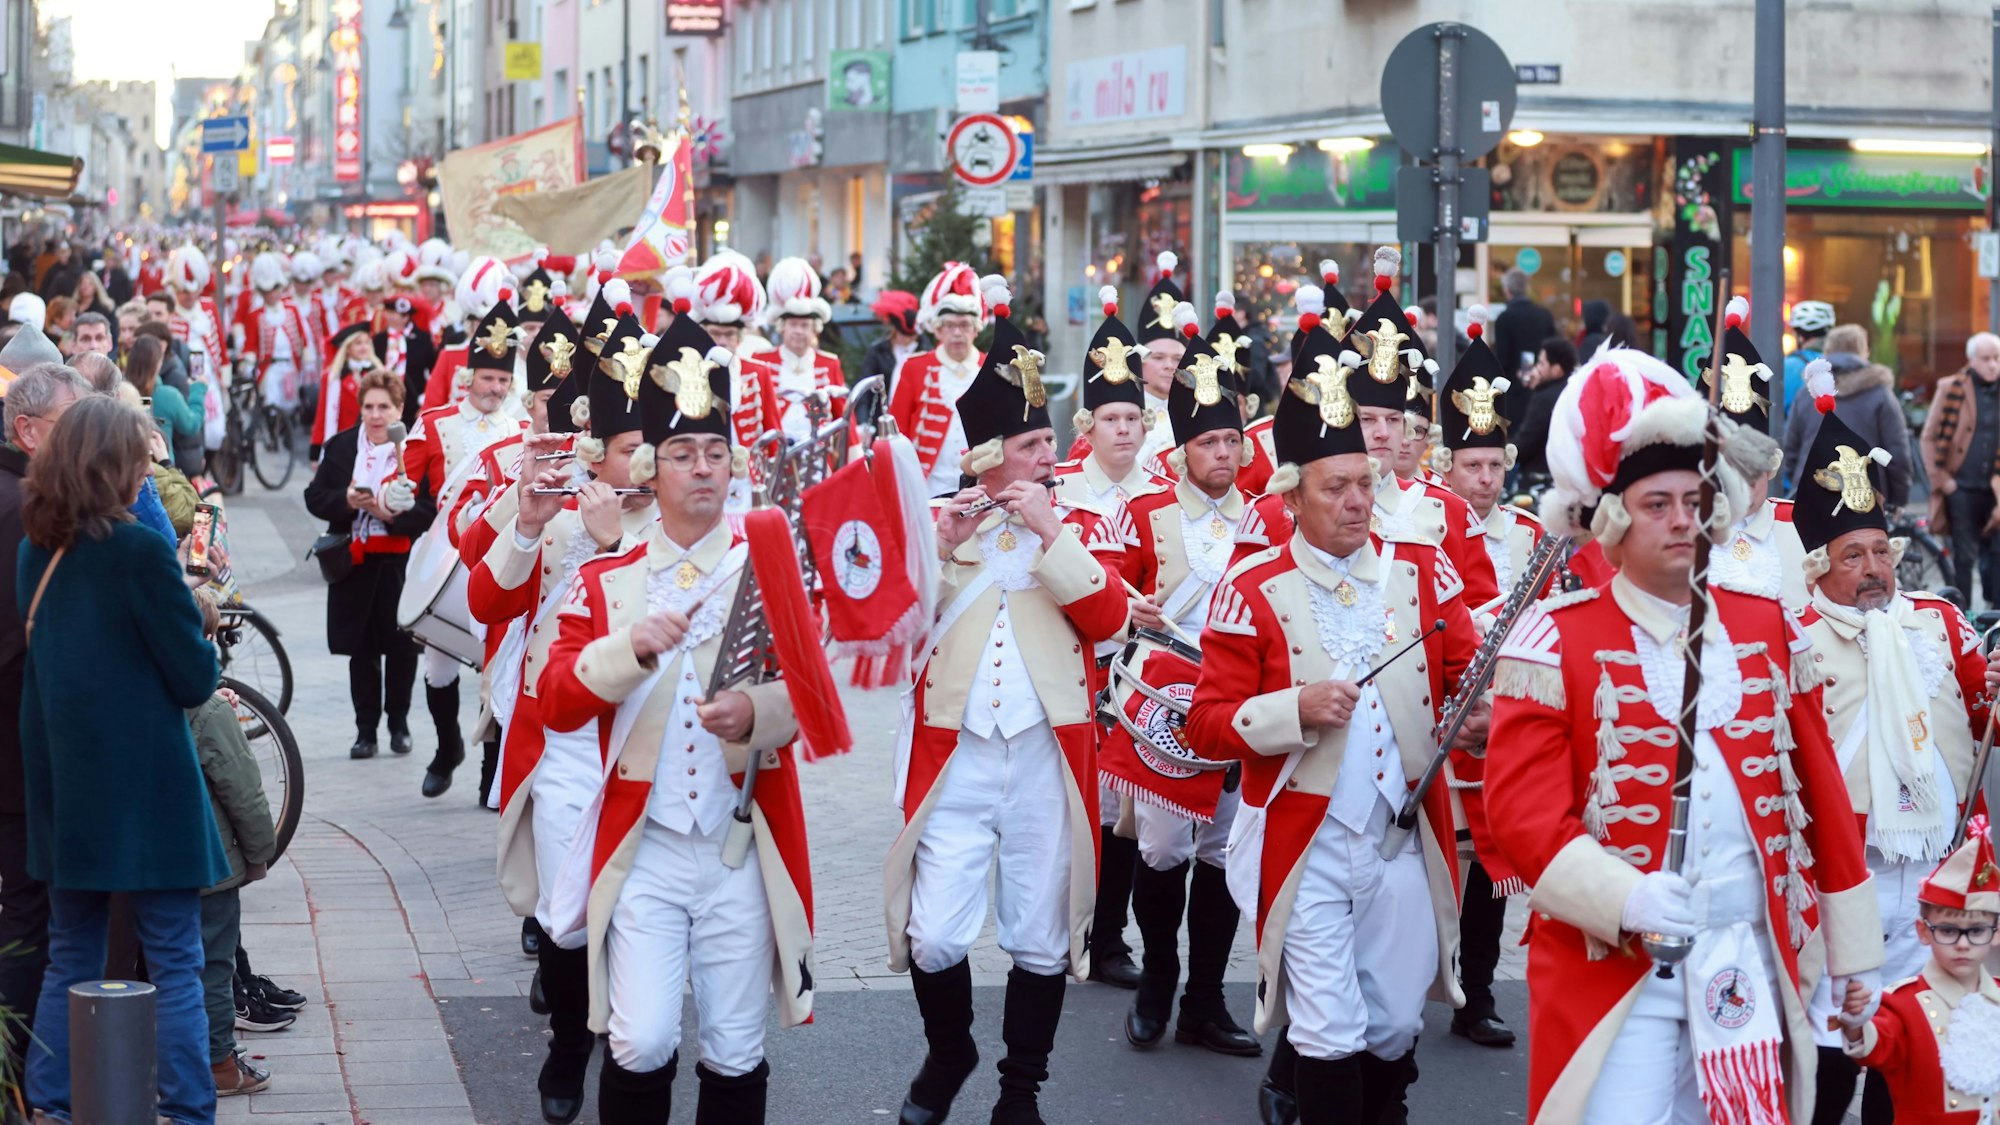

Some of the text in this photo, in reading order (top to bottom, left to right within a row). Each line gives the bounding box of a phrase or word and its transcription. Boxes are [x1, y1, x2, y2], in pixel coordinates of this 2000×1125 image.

[1147, 71, 1168, 113] ru
[1680, 245, 1714, 389] SNAC
[1168, 686, 1192, 698] Fun
